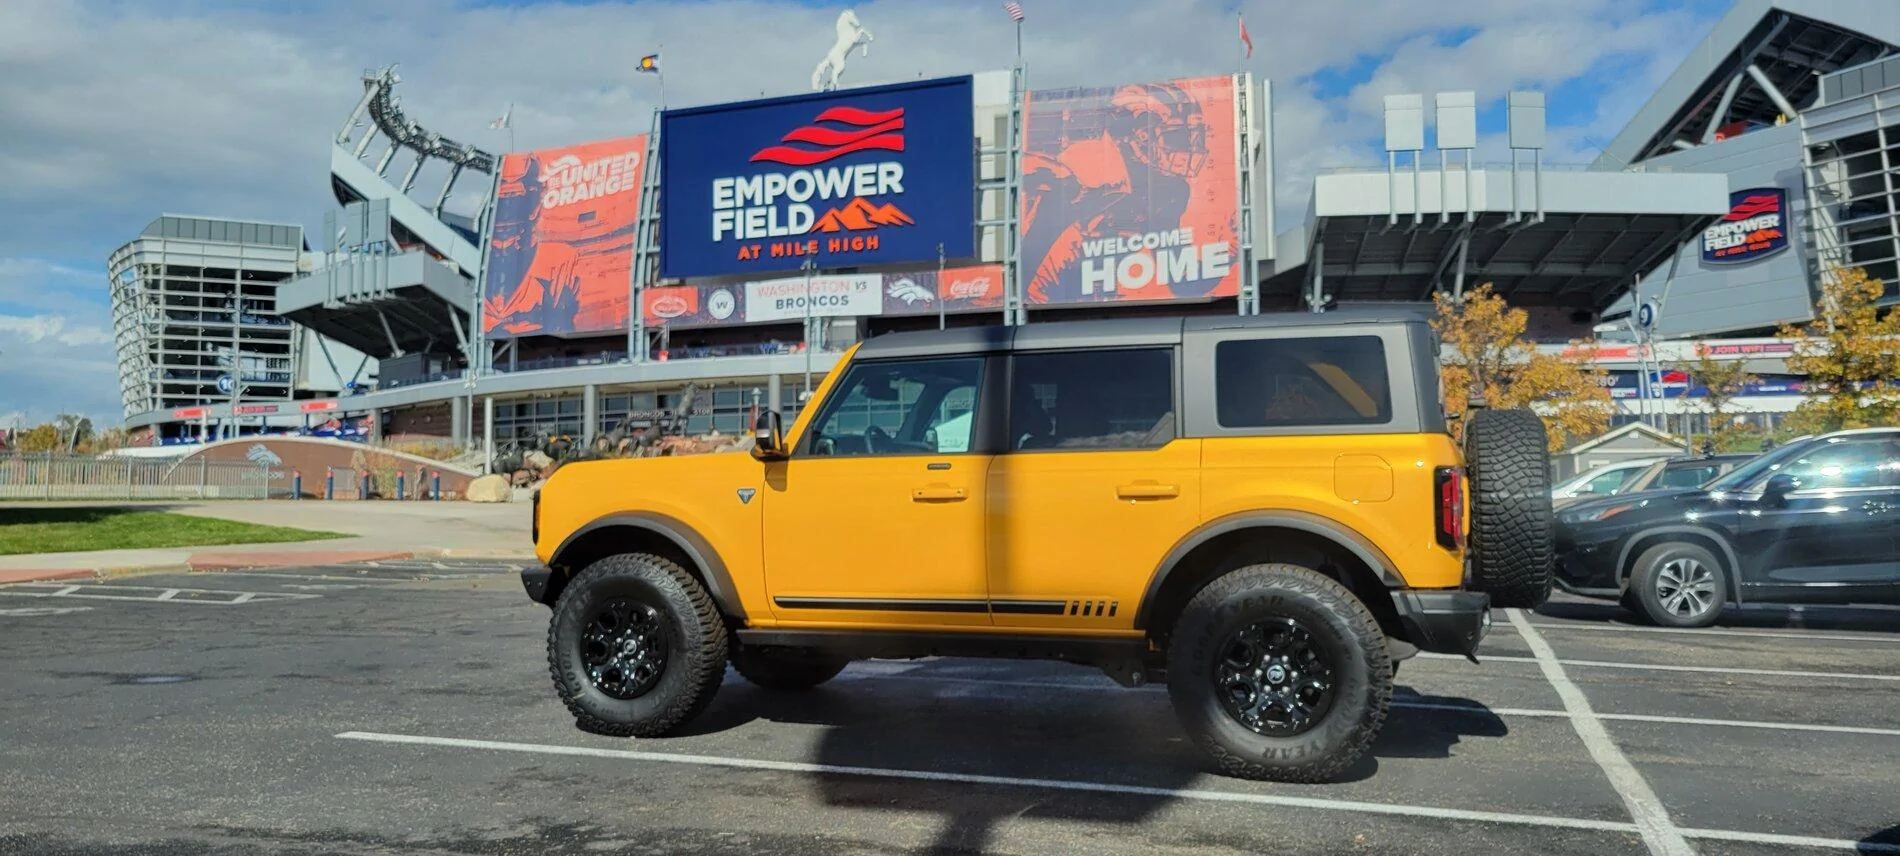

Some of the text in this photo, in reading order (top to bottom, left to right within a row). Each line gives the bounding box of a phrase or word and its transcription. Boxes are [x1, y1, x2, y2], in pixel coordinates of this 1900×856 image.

[561, 151, 641, 187] UNITED
[543, 171, 636, 210] ORANGE
[712, 161, 905, 211] EMPOWER
[712, 203, 816, 242] FIELD
[1704, 214, 1779, 240] EMPOWER
[737, 234, 880, 261] AT MILE HIGH
[1082, 228, 1193, 258] WELCOME
[1704, 233, 1747, 252] FIELD
[1081, 241, 1231, 296] HOME
[757, 279, 851, 297] WASHINGTON
[775, 295, 850, 310] BRONCOS
[1640, 308, 1649, 324] 9
